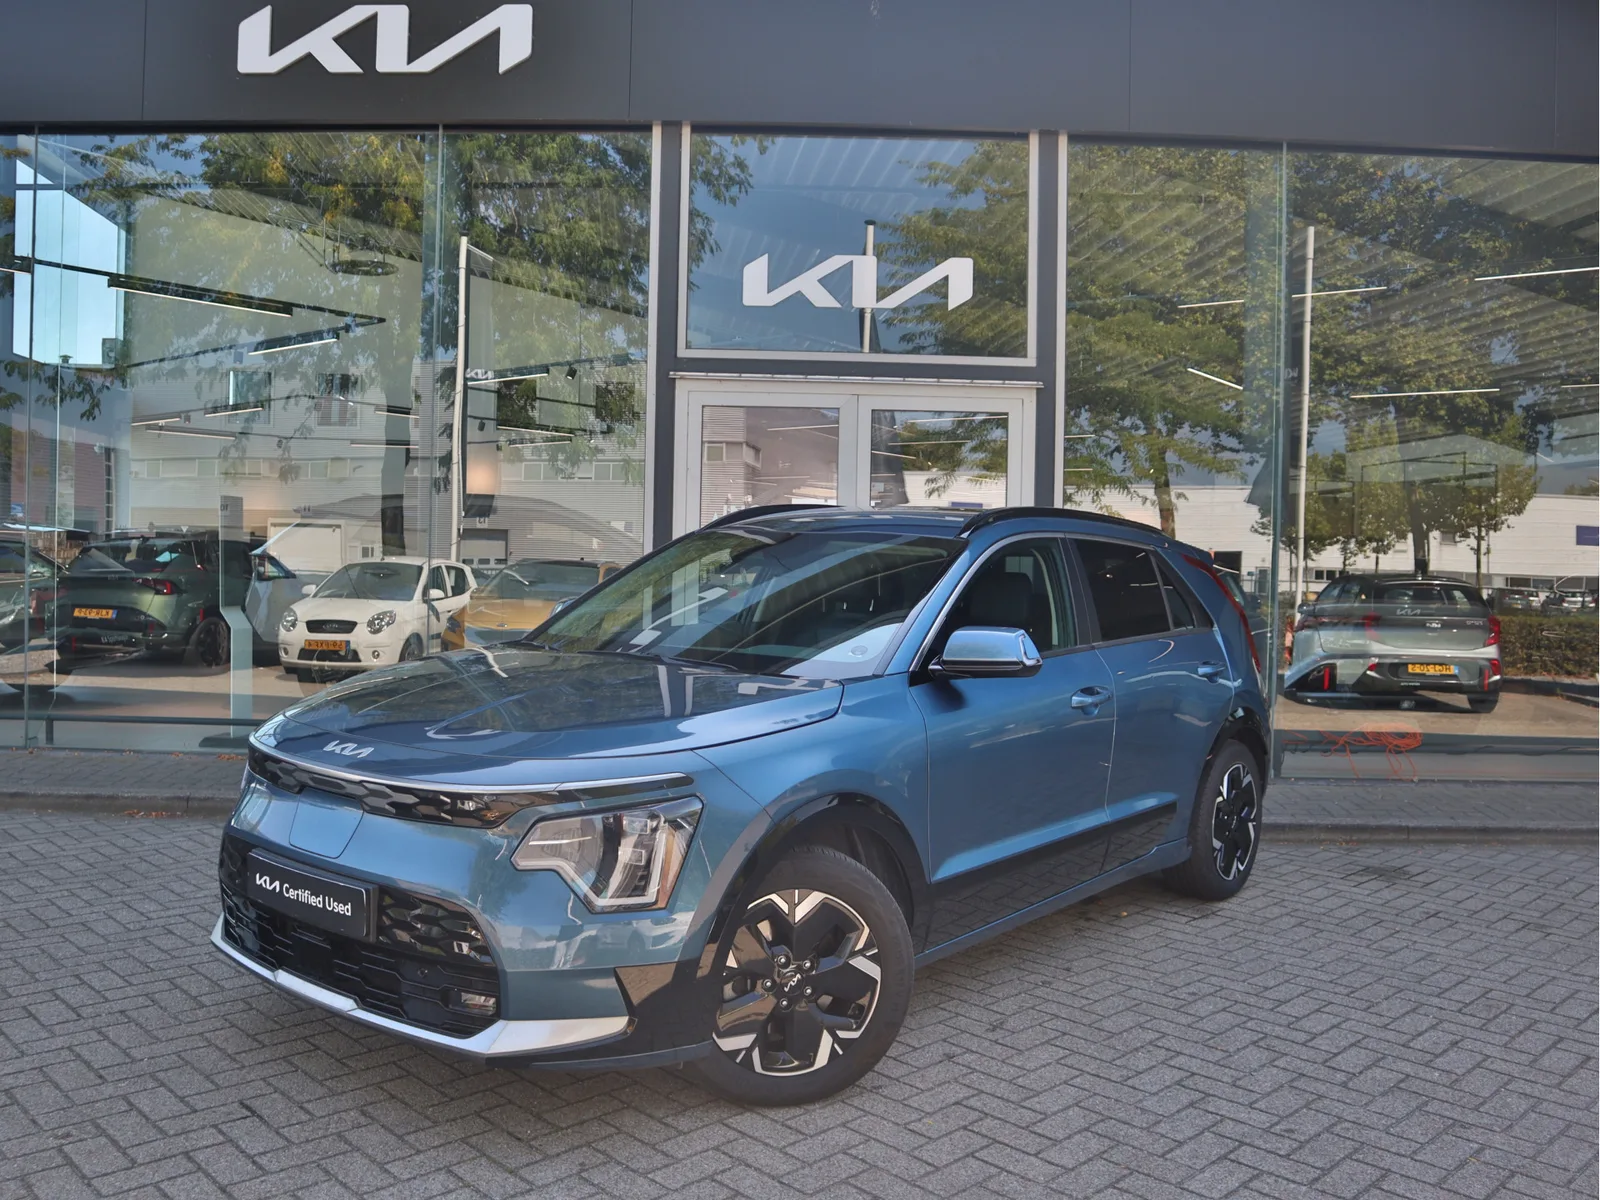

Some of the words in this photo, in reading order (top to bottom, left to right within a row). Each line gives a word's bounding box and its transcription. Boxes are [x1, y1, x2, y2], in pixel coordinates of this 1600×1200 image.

[237, 3, 533, 75] KIA
[743, 253, 974, 311] KIA
[323, 740, 375, 758] KIA
[256, 872, 280, 893] KIA
[283, 883, 323, 908] Certified
[325, 895, 352, 916] Used
